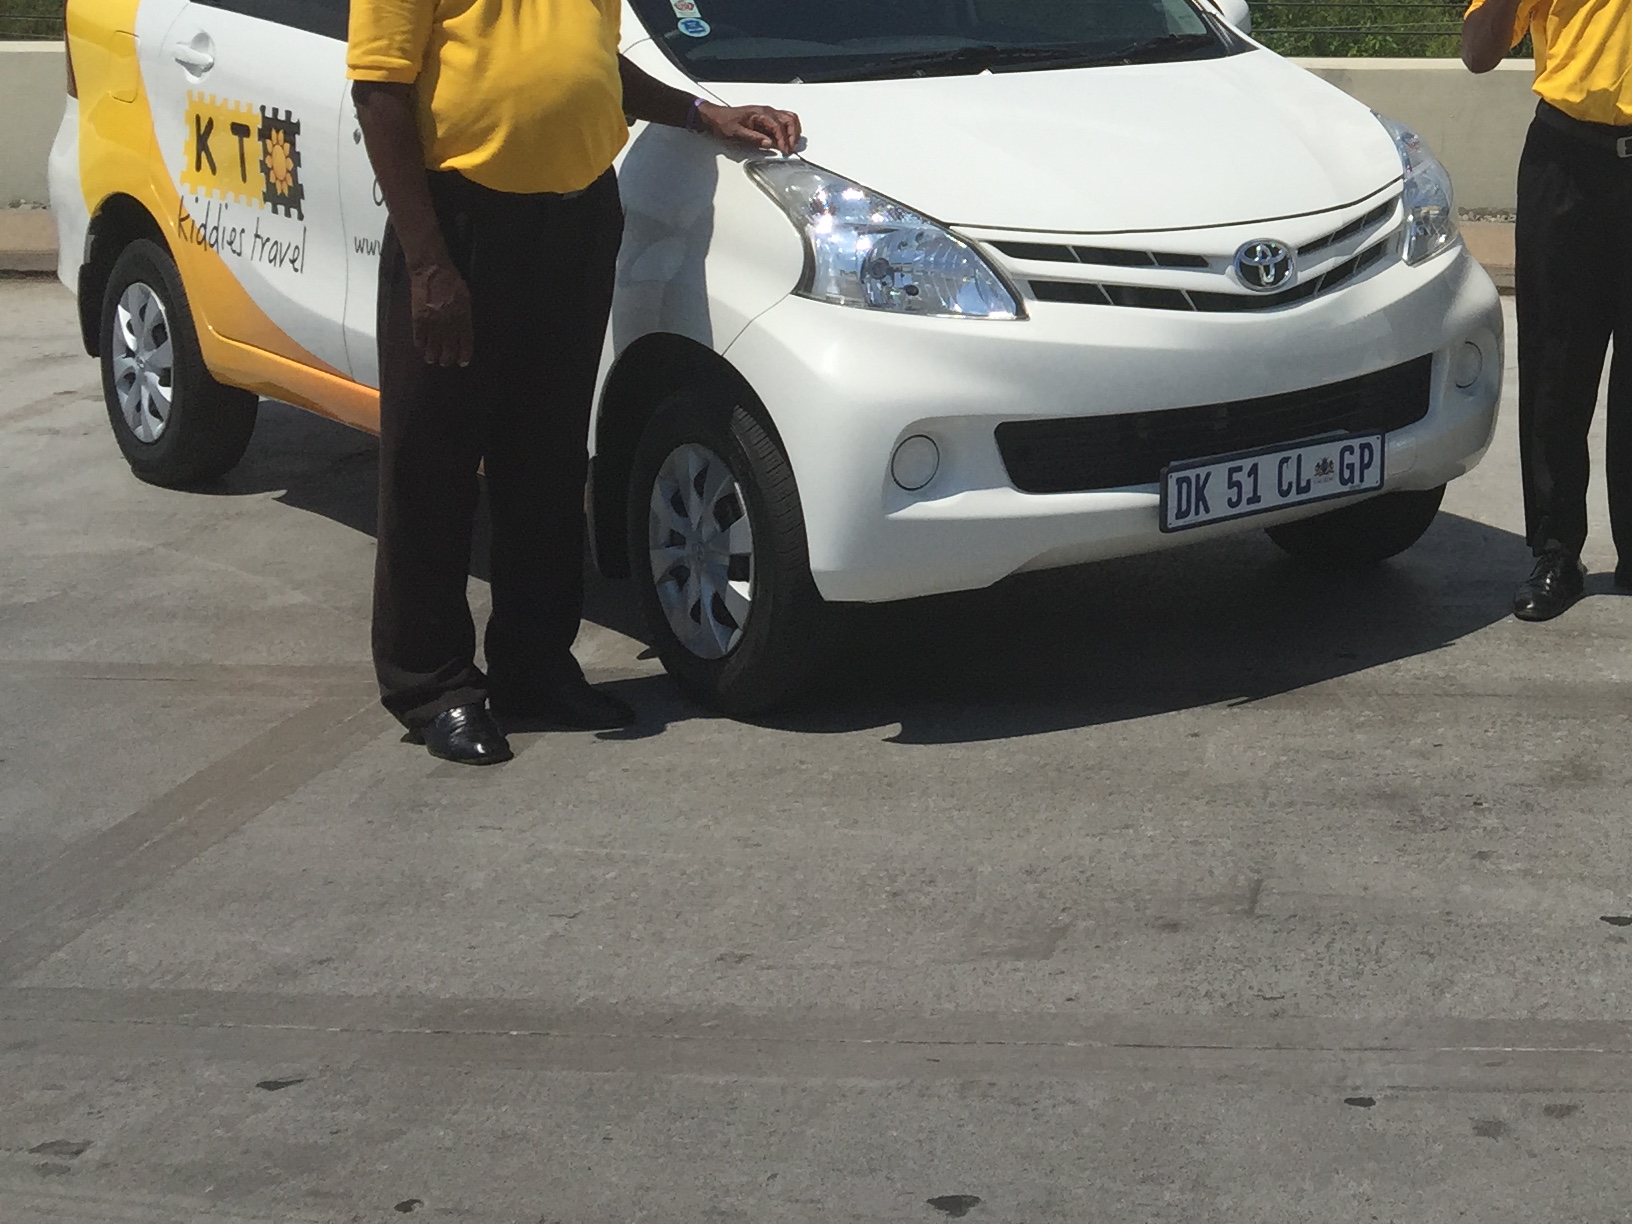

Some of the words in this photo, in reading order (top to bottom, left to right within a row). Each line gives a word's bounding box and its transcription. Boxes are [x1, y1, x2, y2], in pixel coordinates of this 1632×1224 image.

[177, 195, 246, 258] kiddies
[250, 216, 307, 274] travel
[1174, 470, 1213, 521] DK
[1226, 462, 1262, 509] 51
[1276, 452, 1312, 499] CL
[1338, 441, 1375, 487] GP
